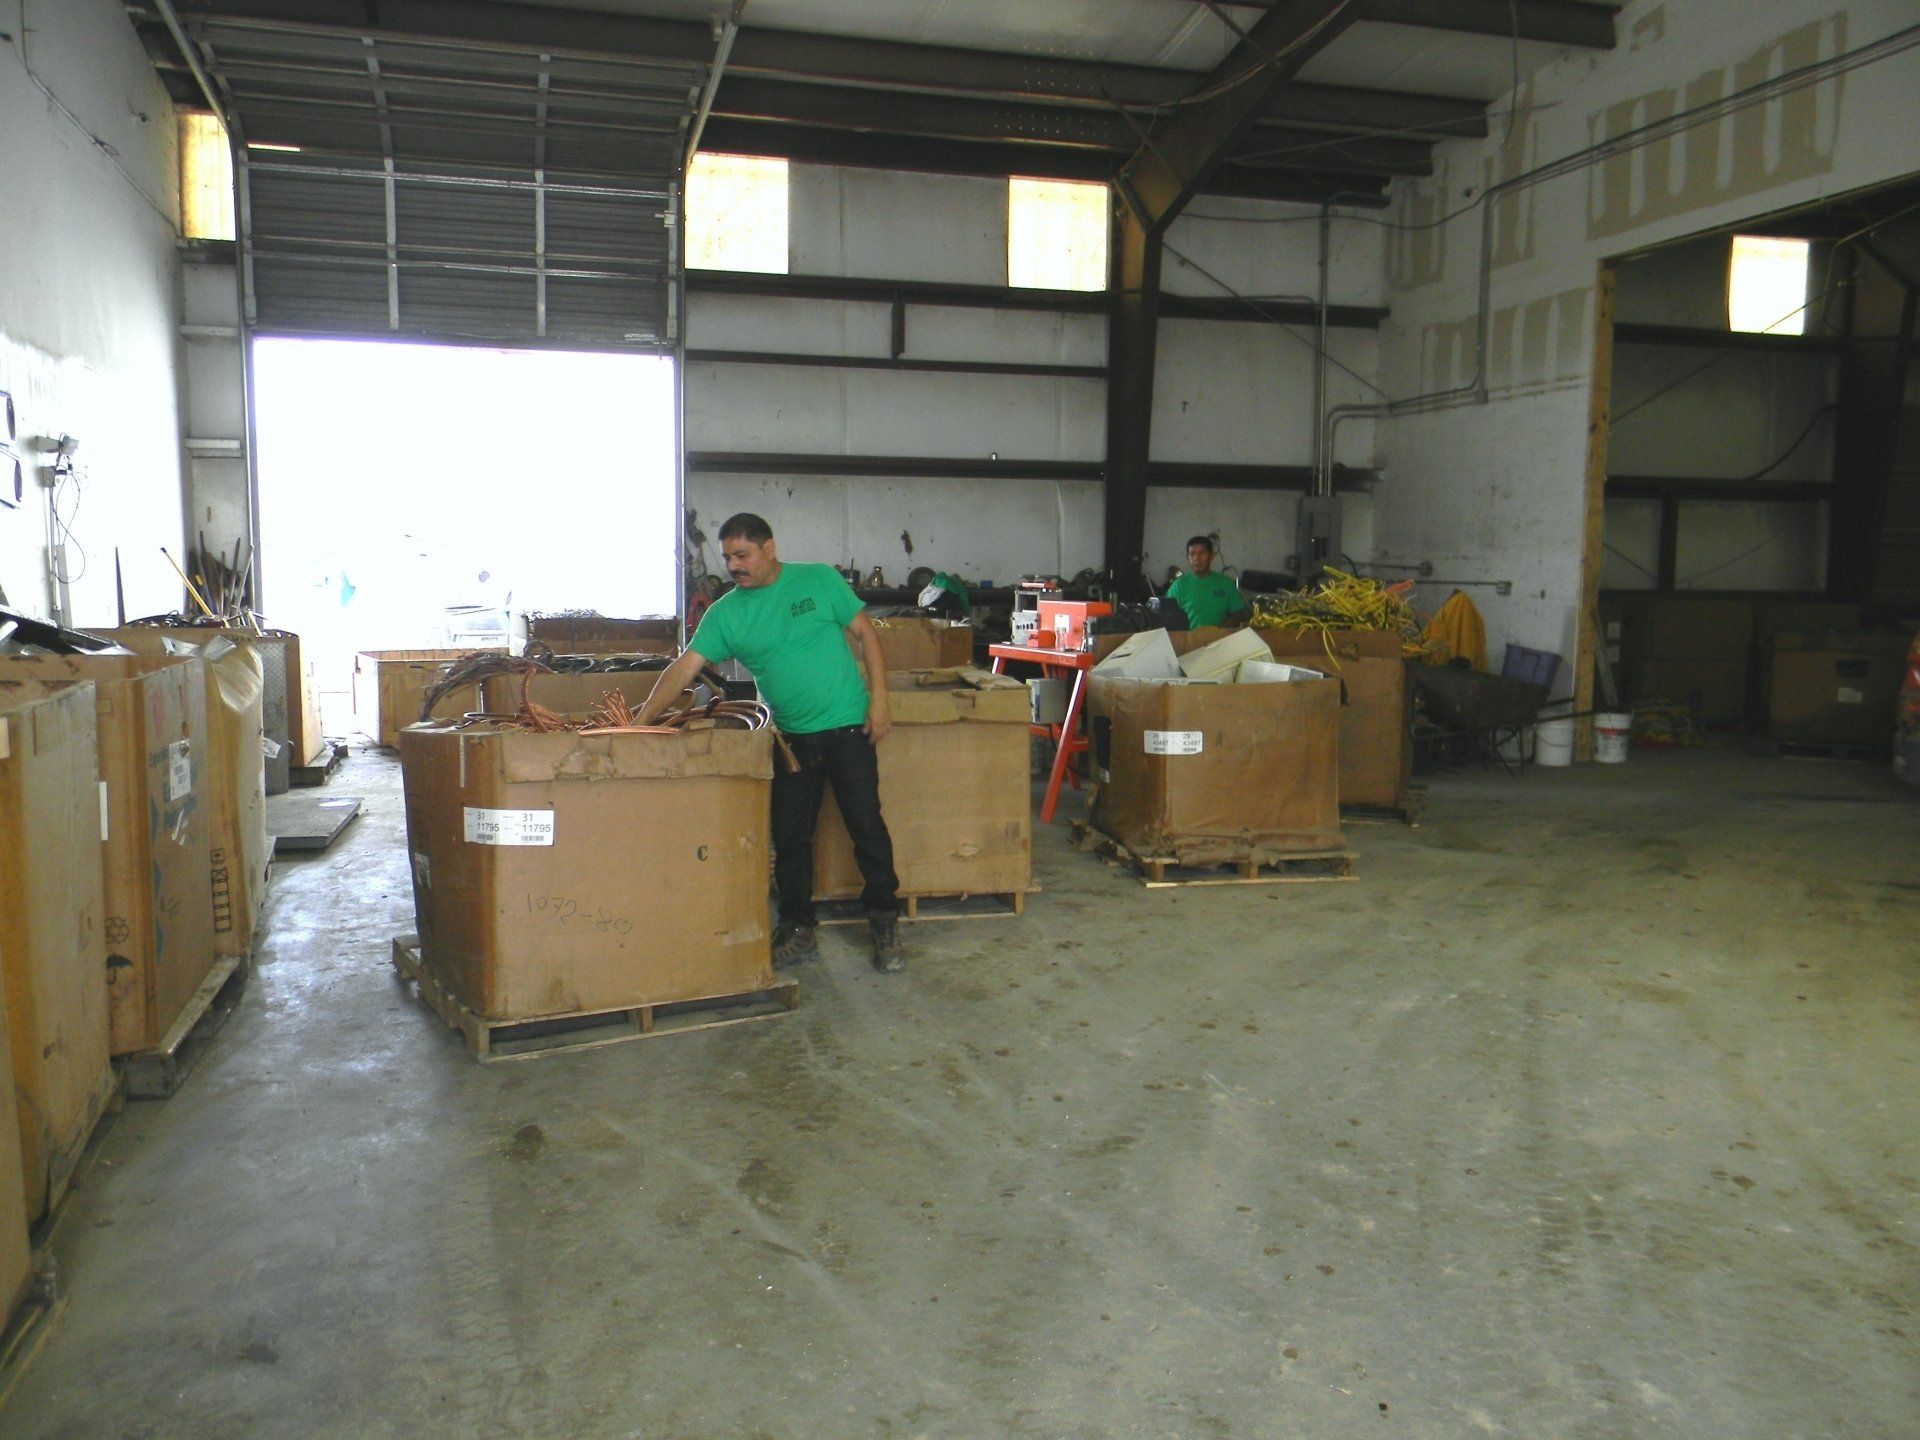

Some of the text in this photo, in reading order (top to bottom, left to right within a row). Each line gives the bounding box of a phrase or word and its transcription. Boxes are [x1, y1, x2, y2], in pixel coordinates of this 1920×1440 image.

[476, 811, 485, 820] 31
[522, 813, 533, 822] 31
[477, 822, 500, 832] 11795
[522, 823, 551, 832] 11795
[697, 845, 708, 861] C
